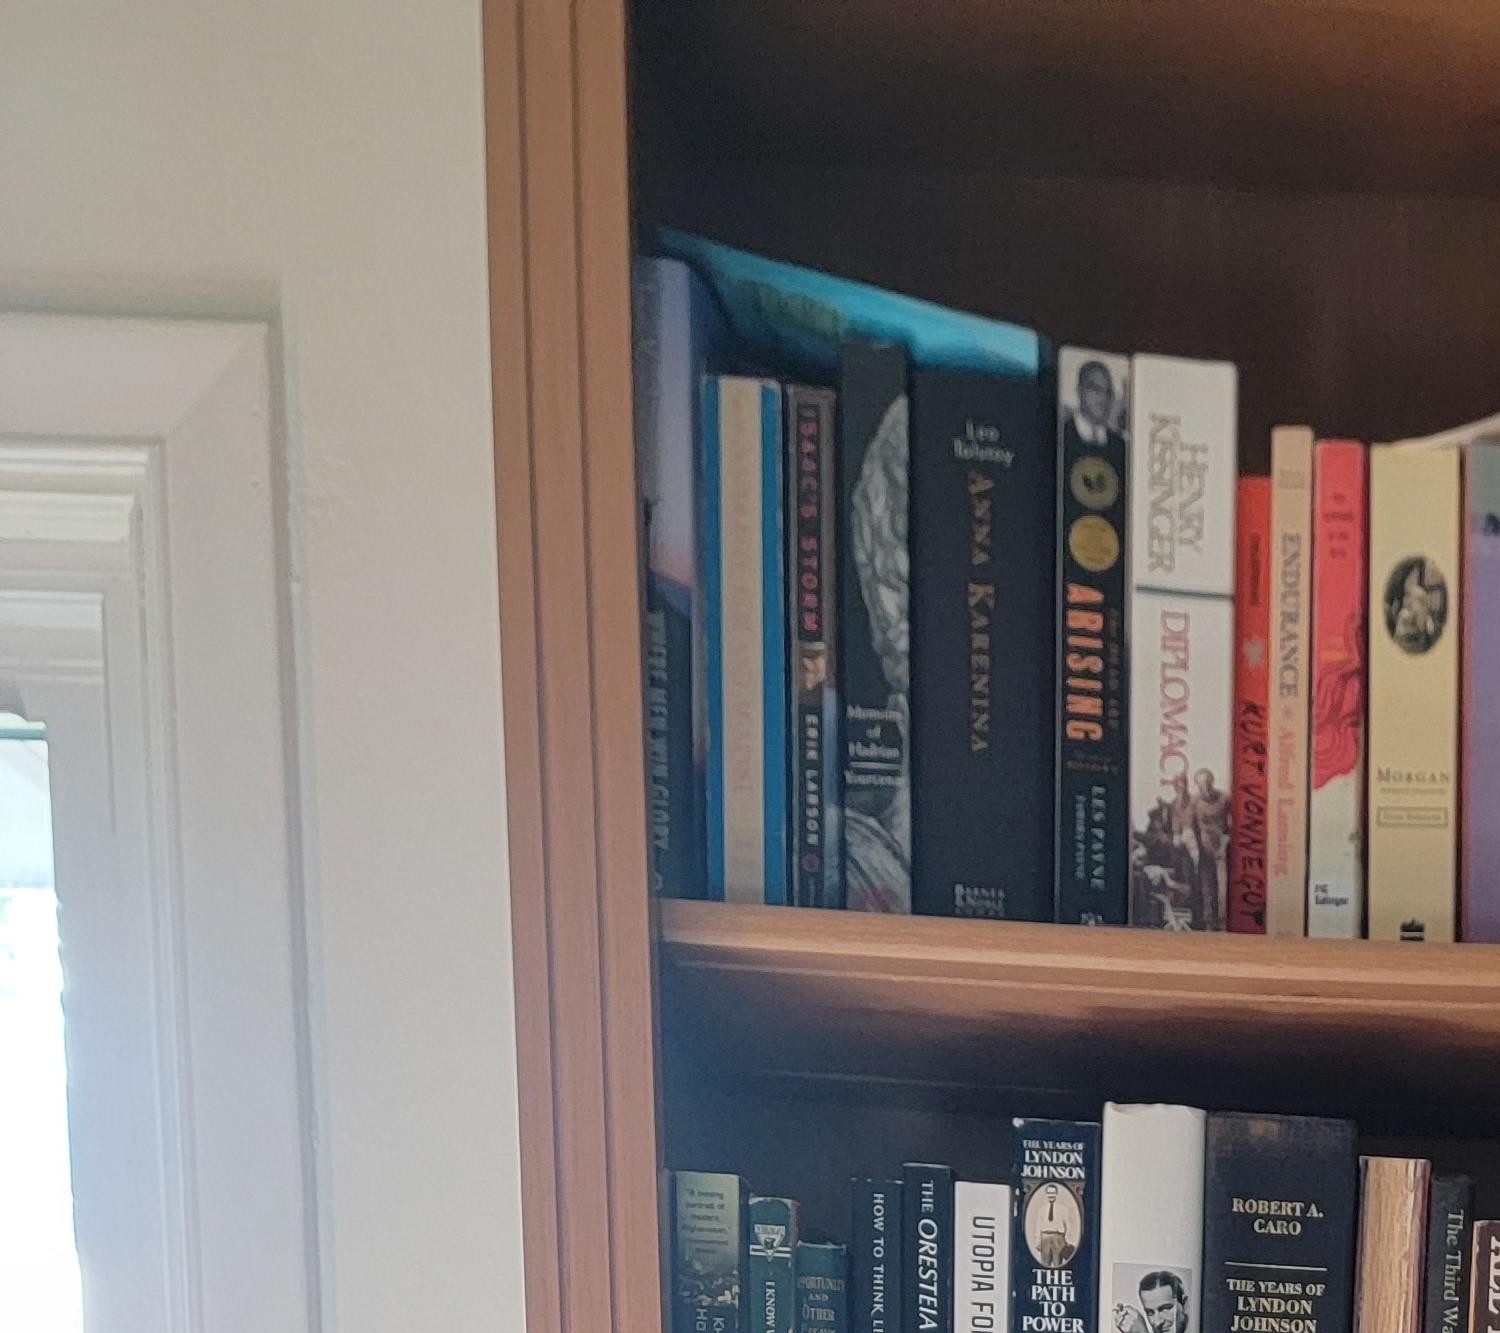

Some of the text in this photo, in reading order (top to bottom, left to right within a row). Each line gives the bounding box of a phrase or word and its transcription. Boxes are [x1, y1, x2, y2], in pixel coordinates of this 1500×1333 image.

[1147, 412, 1181, 574] KISSINGER
[1178, 443, 1208, 555] HENRY
[966, 469, 995, 754] ANNA KARENINA
[1064, 583, 1105, 742] ARISING
[1278, 532, 1302, 697] ENDURANCE
[1157, 610, 1191, 792] DIPLOMACY
[804, 714, 819, 845] ERIK LARSON
[1239, 700, 1266, 926] KURT VONNEGUT
[765, 1288, 776, 1324] KNOW
[917, 1180, 938, 1331] THE ORESTEIA
[970, 1216, 995, 1293] UTOPIA
[1031, 1284, 1076, 1302] PATH
[1032, 1268, 1074, 1286] THE
[1040, 1302, 1067, 1318] TO
[1021, 1315, 1084, 1333] POWER
